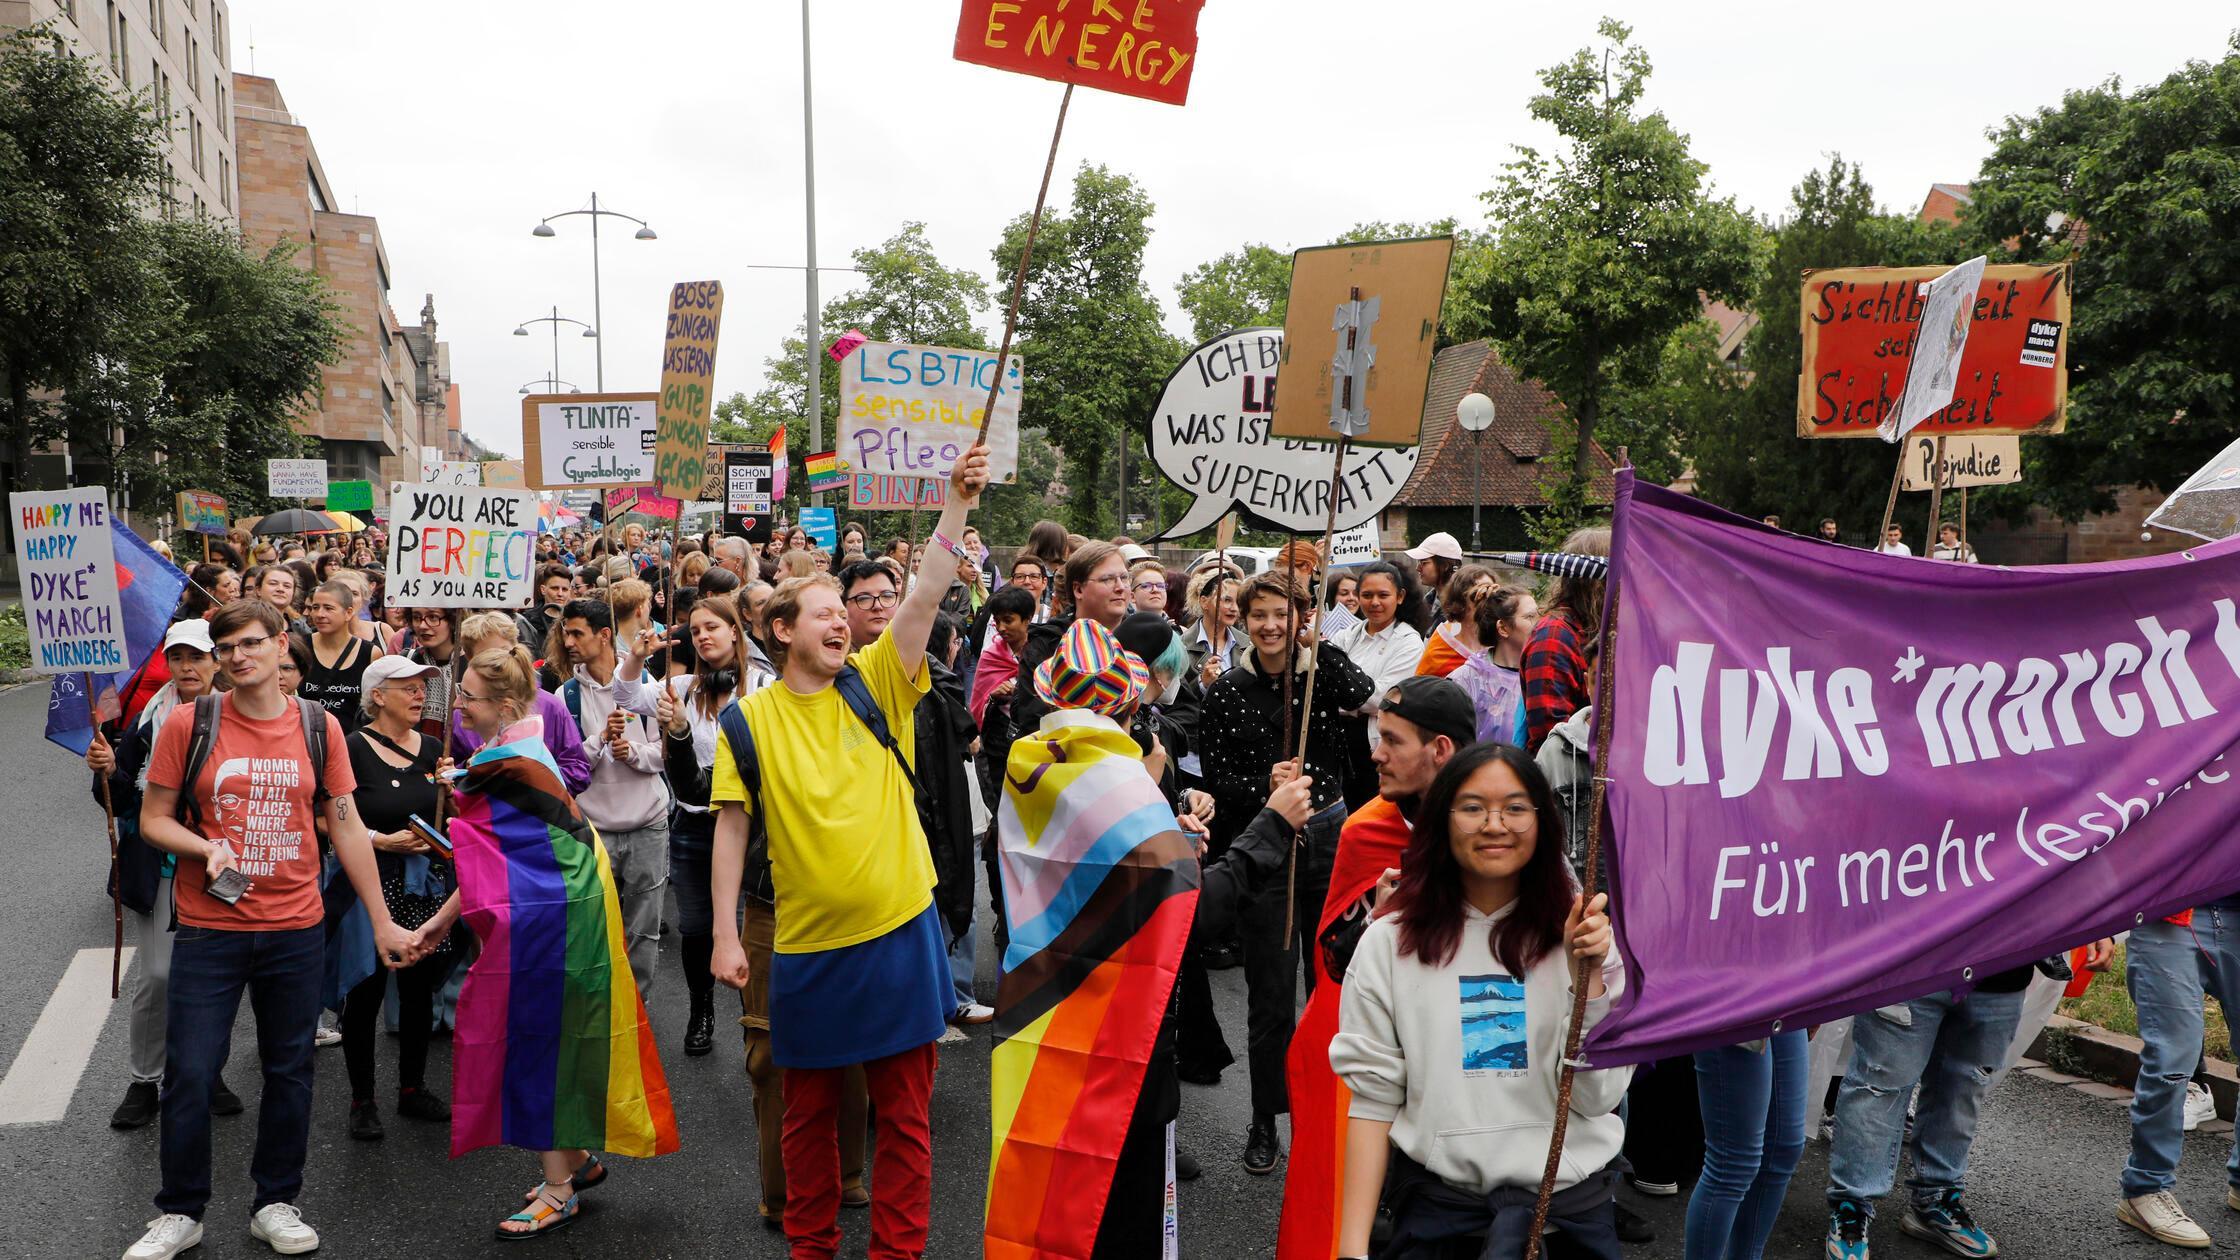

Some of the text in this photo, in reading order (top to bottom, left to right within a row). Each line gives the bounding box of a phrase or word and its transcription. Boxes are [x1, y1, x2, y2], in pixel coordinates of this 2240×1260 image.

[984, 2, 1190, 86] ENERGY
[2028, 336, 2055, 348] march
[1197, 340, 1248, 388] ICH
[853, 393, 986, 429] sensible
[1167, 413, 1226, 447] WAS
[572, 435, 615, 450] sensible
[853, 427, 961, 476] Pfleg
[271, 461, 316, 470] GIRLS JUST
[562, 455, 641, 482] Gynäkologie
[731, 467, 766, 478] SCHÖN
[272, 471, 319, 479] WANNA HAVE
[272, 478, 323, 486] FUNDAMENTAL
[272, 487, 297, 495] HUMAN
[299, 487, 324, 495] RIGHTS
[731, 481, 754, 491] HEIT
[1182, 454, 1394, 516] SUPERKRAFT
[22, 502, 104, 530] HAPPY ME
[410, 492, 464, 522] YOU
[474, 497, 520, 527] ARE
[26, 534, 78, 561] HAPPY
[1340, 534, 1363, 545] your
[396, 525, 538, 584] PERFECT
[1333, 543, 1372, 555] Cis-ters!
[399, 579, 508, 601] AS YOU ARE
[36, 605, 112, 639] MARCH
[41, 639, 121, 668] NÜRNBERG
[251, 758, 298, 773] WOMEN
[251, 772, 299, 787] BELONG
[249, 786, 287, 802] IN ALL
[247, 801, 292, 817] PLACES
[246, 815, 287, 832] WHERE
[244, 831, 302, 846] DECISIONS
[242, 846, 299, 861] ARE BEING
[240, 861, 276, 877] MADE
[1710, 841, 1815, 921] Für
[1837, 819, 1996, 908] mehr
[1165, 1181, 1175, 1238] VIELFALT
